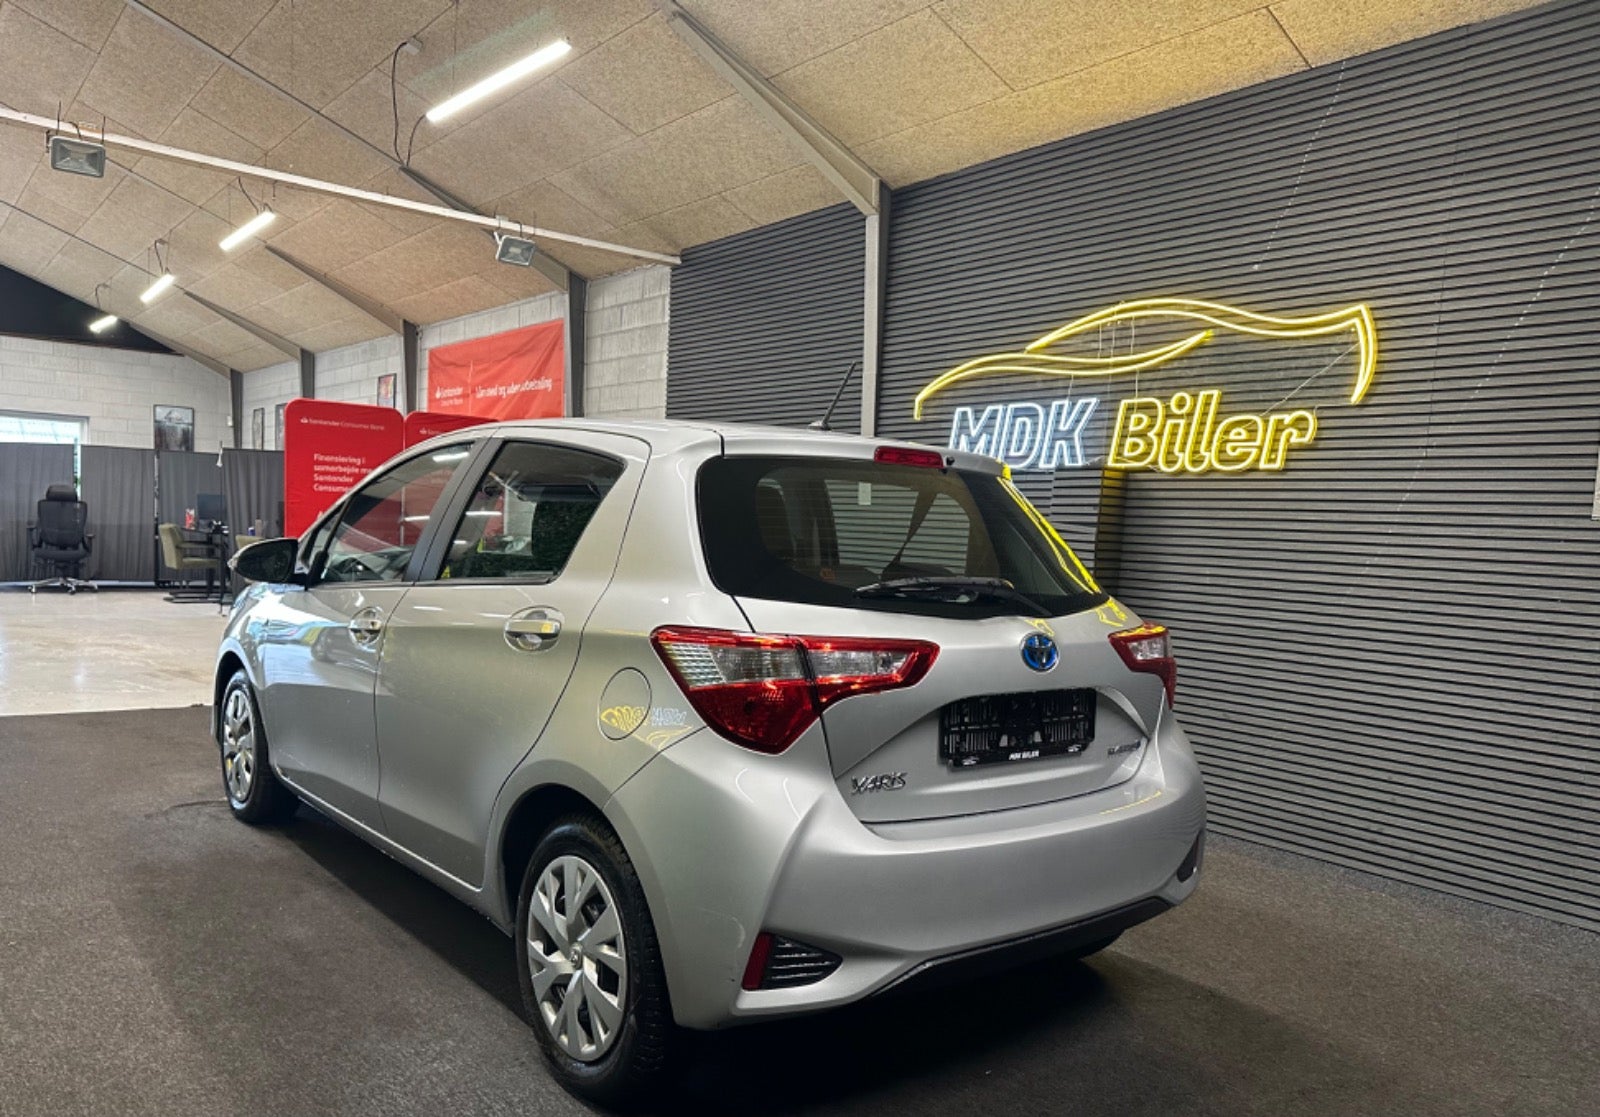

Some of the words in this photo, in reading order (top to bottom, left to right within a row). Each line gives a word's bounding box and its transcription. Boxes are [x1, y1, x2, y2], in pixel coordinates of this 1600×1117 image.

[947, 397, 1098, 470] MDK
[1107, 389, 1317, 473] Biler
[313, 453, 361, 466] Finansiering
[313, 464, 360, 475] samarbejde
[313, 473, 353, 483] Santander
[313, 483, 353, 493] Consume
